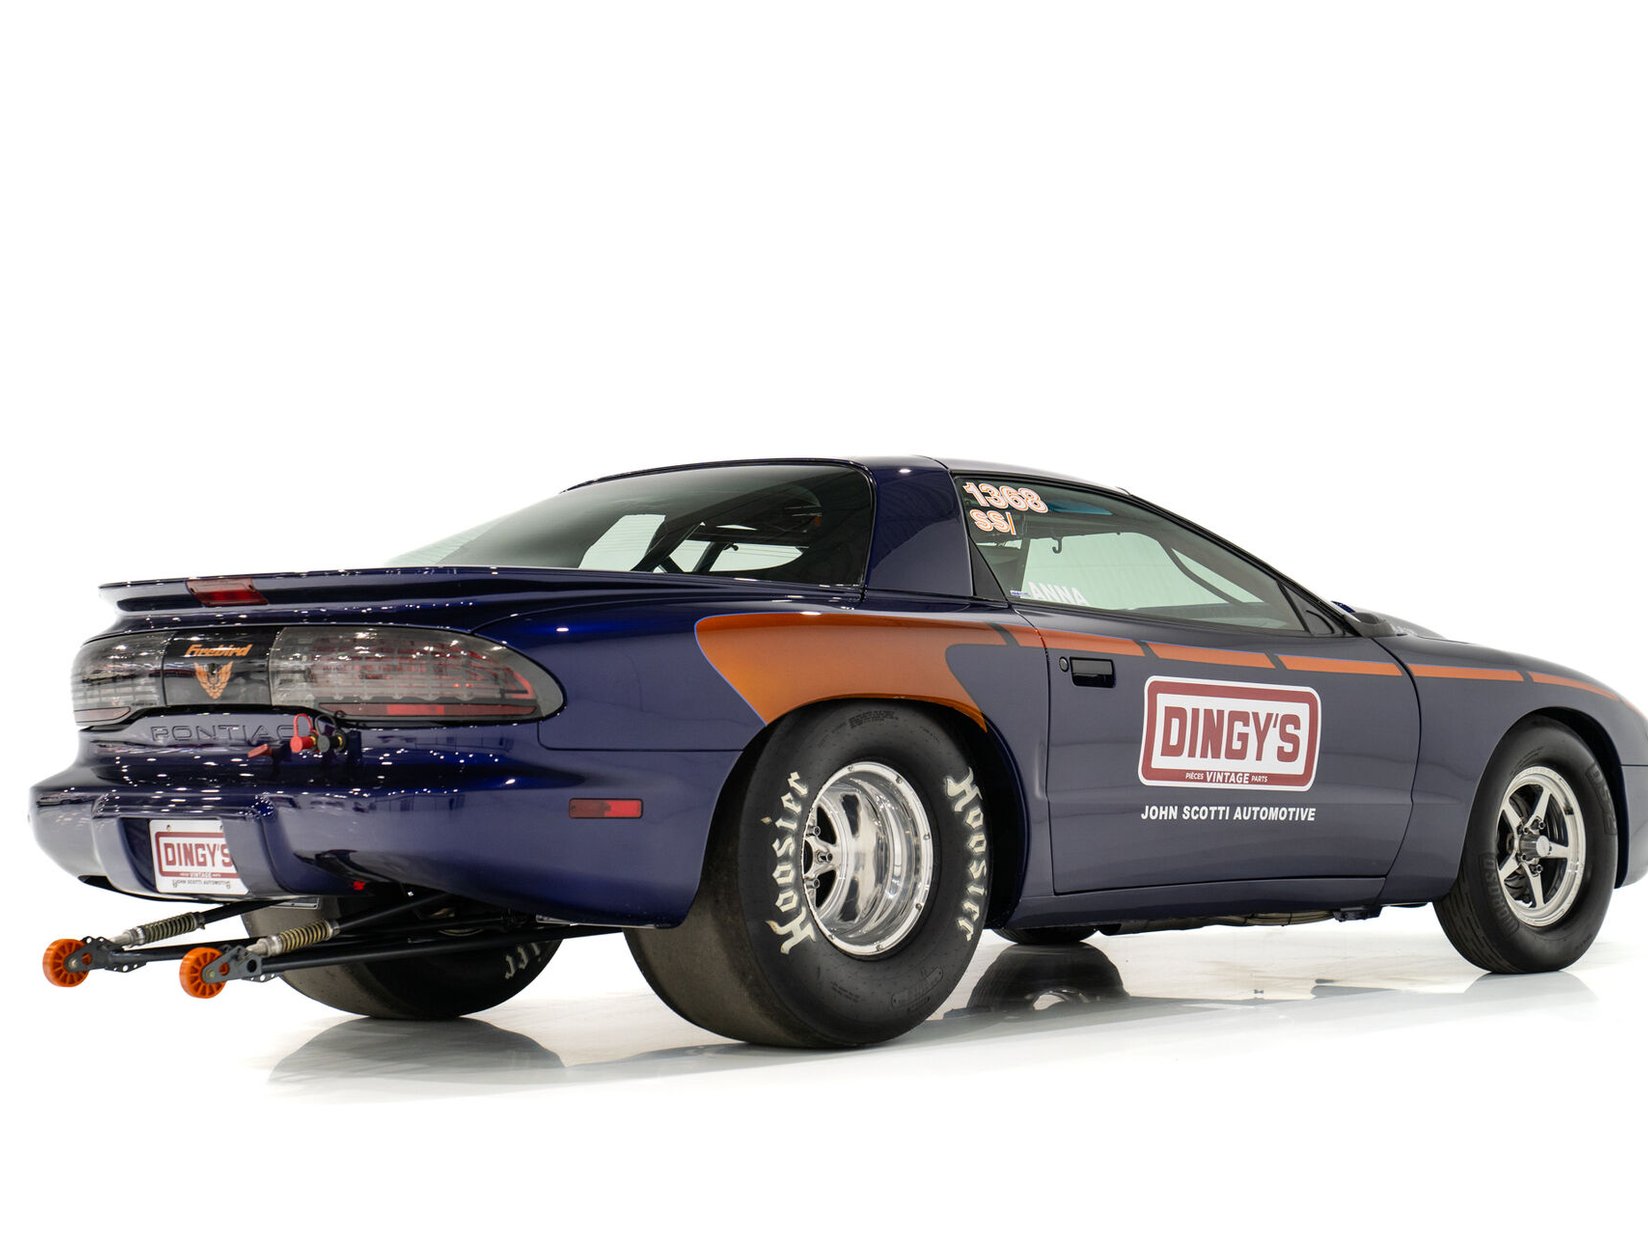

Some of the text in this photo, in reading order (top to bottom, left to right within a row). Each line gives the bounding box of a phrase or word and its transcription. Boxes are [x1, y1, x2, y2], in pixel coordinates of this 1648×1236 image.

[963, 482, 1048, 513] 1368
[1028, 581, 1090, 607] ANNA
[184, 643, 254, 657] Firebird
[1160, 706, 1301, 763] DINGY'S
[1206, 771, 1249, 784] VINTAGE
[1251, 775, 1268, 783] PARTS
[1141, 805, 1316, 821] JOHN SCOTTI AUTOMOTIVE
[164, 843, 233, 868] DINGY'S
[761, 771, 816, 955] Hoosier
[943, 766, 988, 942] Hoosier
